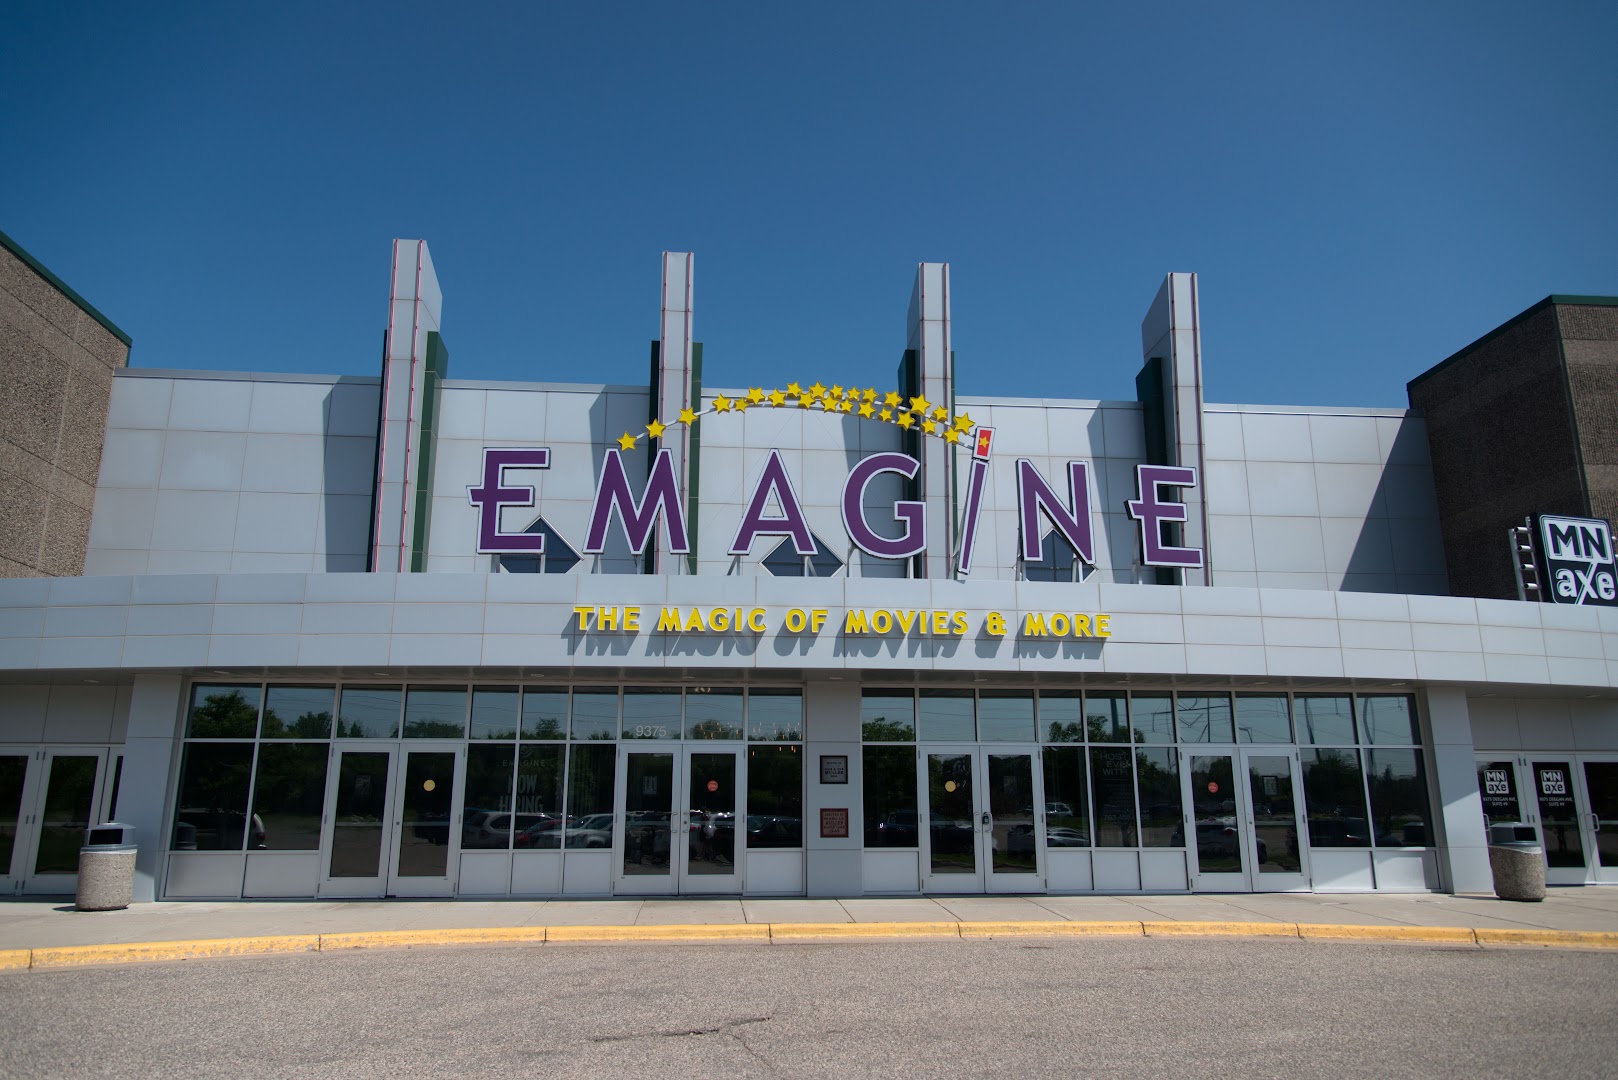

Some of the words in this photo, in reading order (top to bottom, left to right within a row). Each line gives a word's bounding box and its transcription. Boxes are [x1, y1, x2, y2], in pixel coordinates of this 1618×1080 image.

[466, 428, 1206, 576] EMAGINE
[1548, 523, 1609, 560] MN
[573, 605, 641, 632] THE
[657, 606, 768, 633] MAGIC
[784, 607, 829, 633] OF
[844, 608, 969, 636] MOVIES
[986, 610, 1009, 636] &
[1024, 611, 1113, 638] MORE
[635, 725, 667, 737] 9375
[1486, 771, 1506, 782] MN
[1542, 771, 1562, 782] MN
